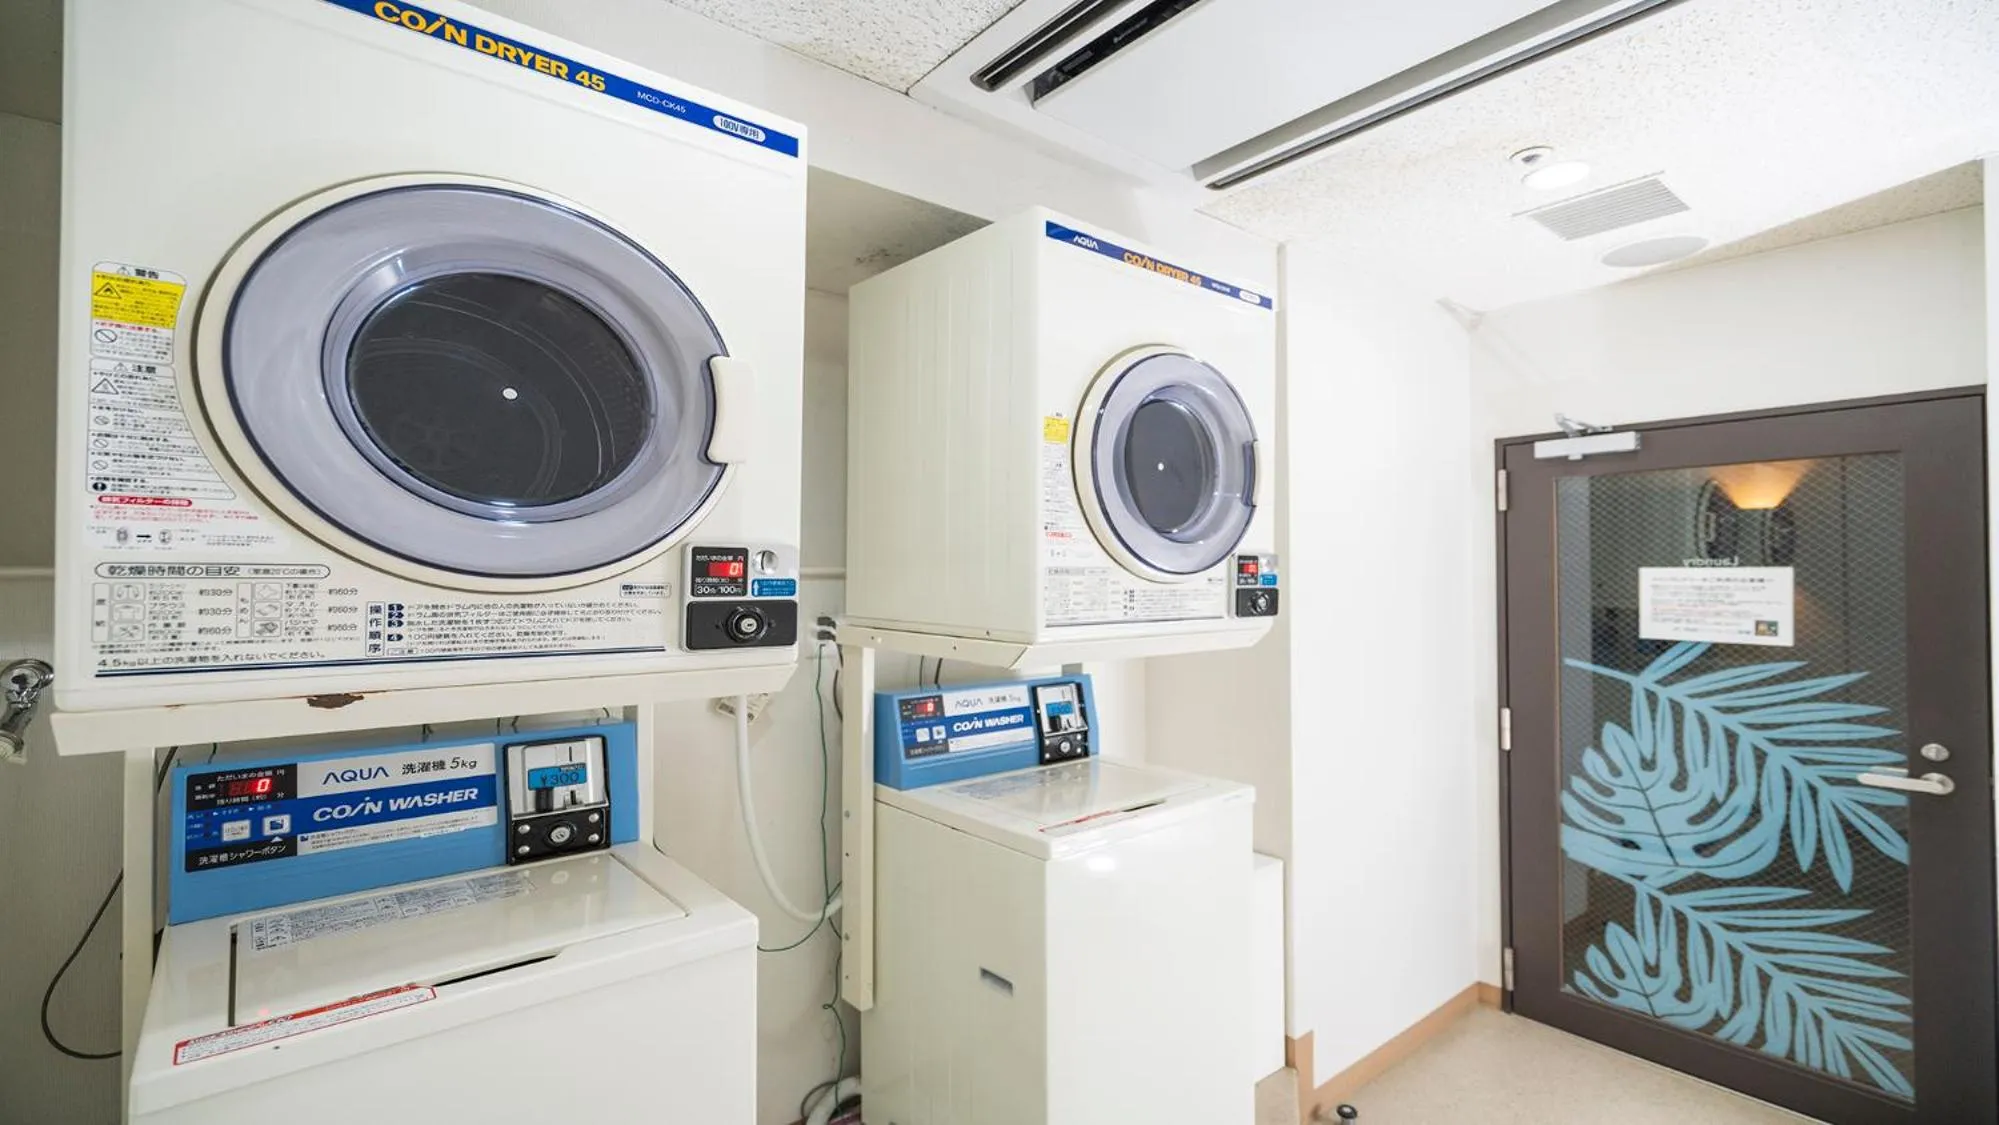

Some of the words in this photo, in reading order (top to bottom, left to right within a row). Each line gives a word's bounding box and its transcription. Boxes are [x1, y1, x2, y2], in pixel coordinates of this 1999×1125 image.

[476, 35, 569, 80] DRYER
[575, 69, 606, 93] 45
[1072, 234, 1099, 251] AQUA
[134, 268, 160, 279] 警告
[1157, 262, 1189, 283] DRYER
[132, 364, 157, 374] 注意
[107, 565, 241, 577] 乾燥時間の目安
[368, 604, 382, 654] 操作順序
[954, 695, 984, 708] AQUA
[984, 713, 1024, 729] WASHER
[401, 759, 447, 776] 洗濯機
[449, 756, 478, 770] 5kg
[216, 769, 273, 783] ただいまの金額
[277, 769, 286, 777] 円
[322, 766, 391, 786] AQUA
[256, 778, 271, 793] 0
[312, 796, 384, 822] COIN
[388, 787, 479, 812] WASHER
[198, 844, 287, 866] 洗濯槽シャワーボタン
